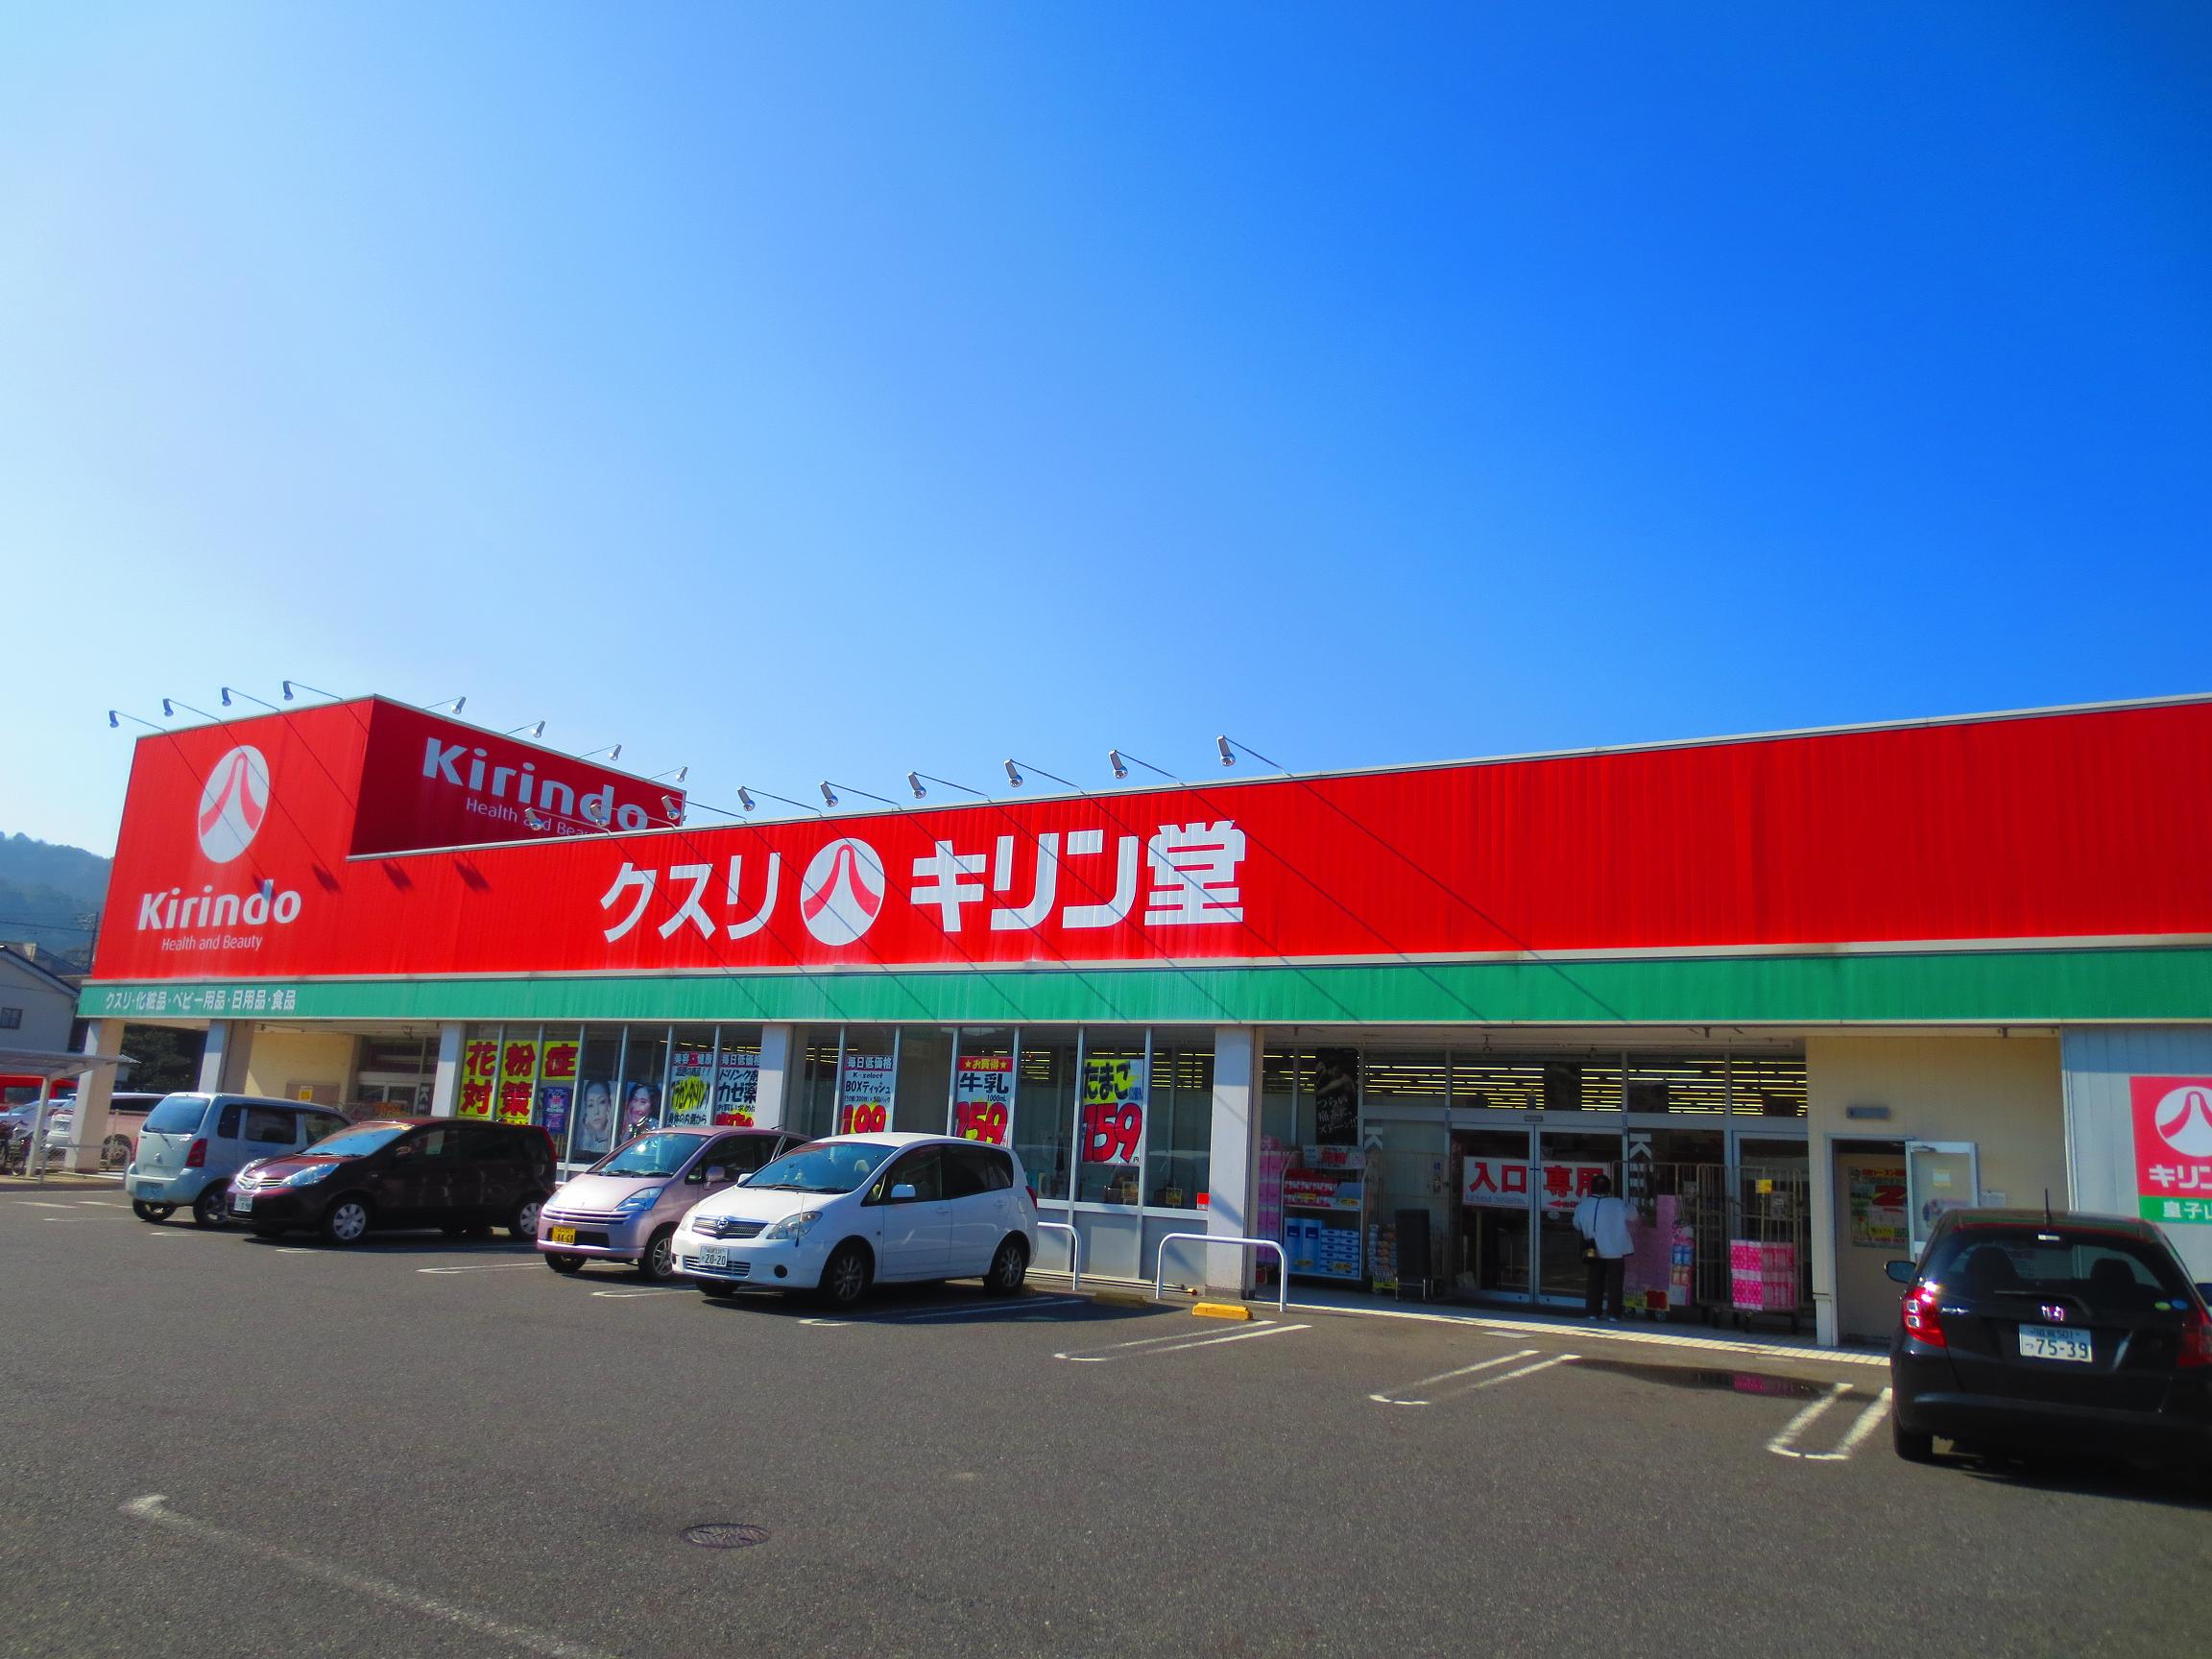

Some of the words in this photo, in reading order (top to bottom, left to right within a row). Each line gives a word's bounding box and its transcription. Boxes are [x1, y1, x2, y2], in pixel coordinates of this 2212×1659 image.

[422, 737, 648, 830] Kirindo
[467, 798, 517, 823] Health
[601, 853, 781, 942] クスリ
[911, 820, 1246, 932] キリン堂
[137, 879, 301, 930] Kirindo
[162, 937, 195, 950] Health
[199, 936, 219, 949] and
[223, 935, 263, 951] Beauty
[467, 1042, 578, 1077] 花粉症
[848, 1057, 893, 1069] 毎日低価格
[461, 1079, 533, 1116] 対策
[718, 1082, 757, 1104] カゼ薬
[845, 1081, 891, 1094] BOXティッシュ
[960, 1072, 1009, 1094] 牛乳
[956, 1101, 1008, 1144] 159
[1082, 1102, 1142, 1163] 159
[2035, 1338, 2089, 1359] 75-39
